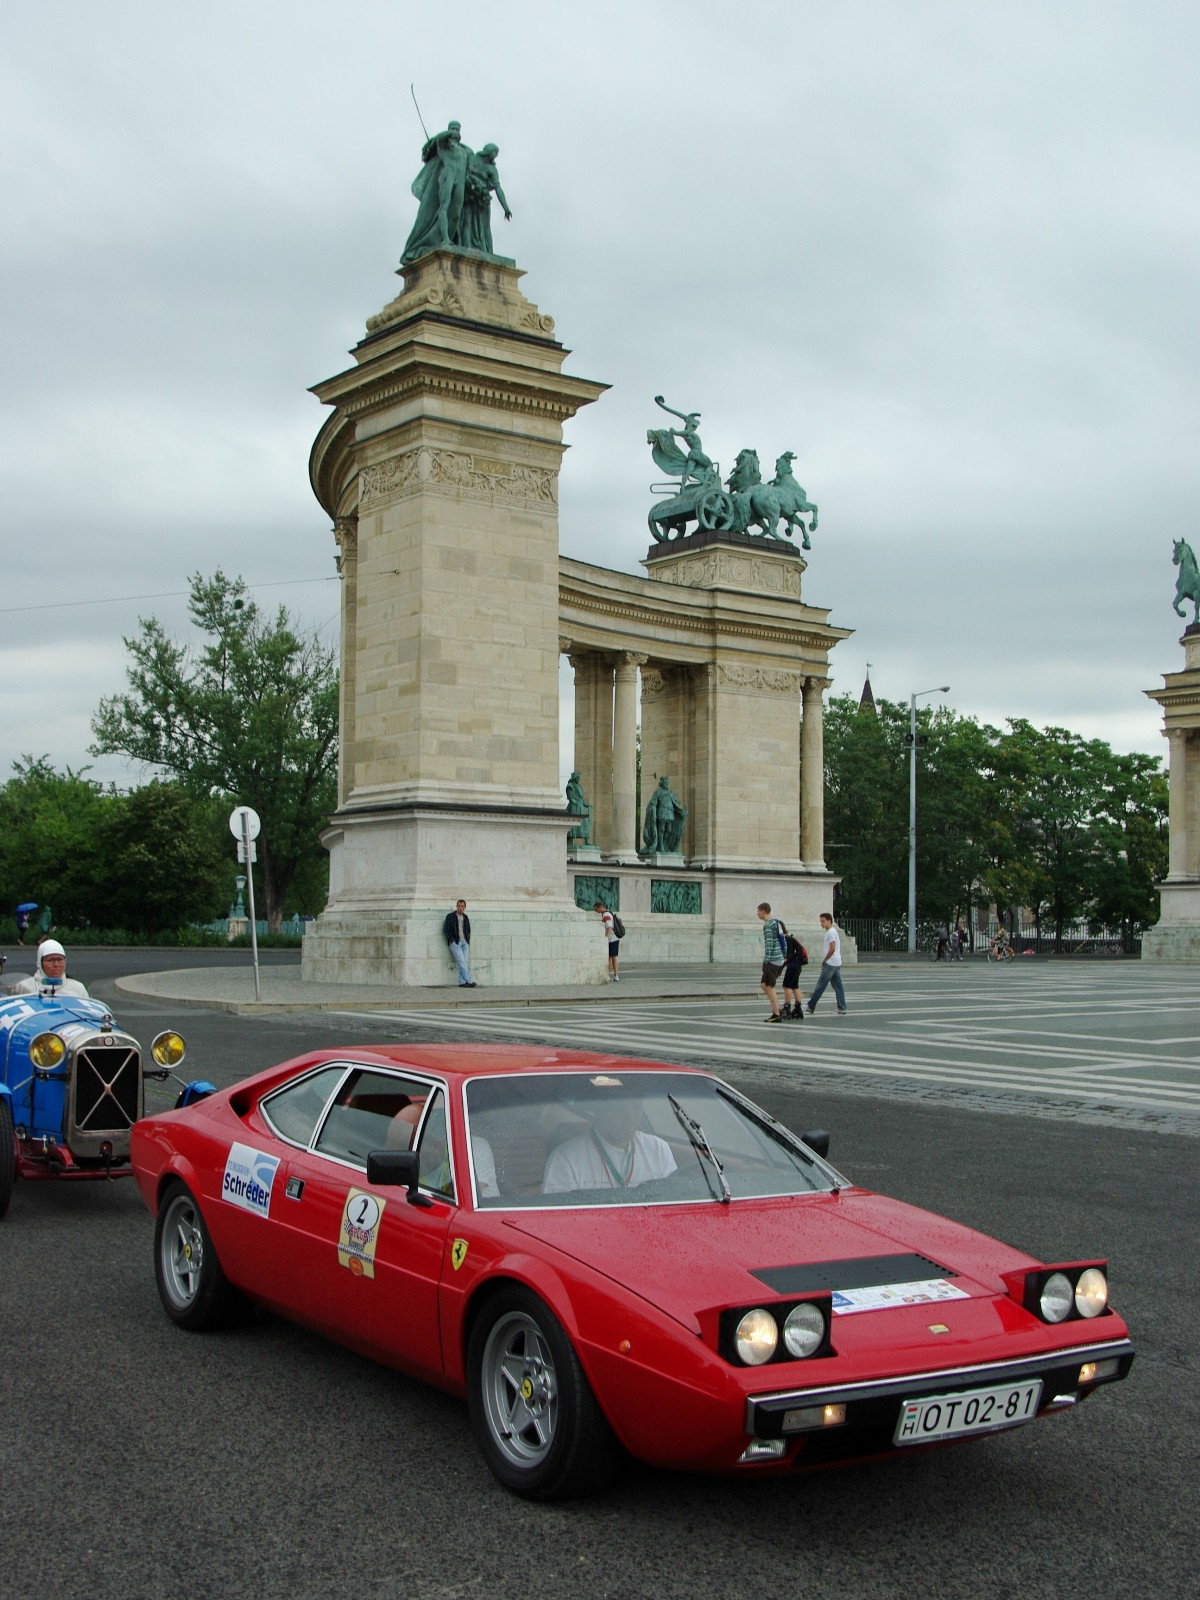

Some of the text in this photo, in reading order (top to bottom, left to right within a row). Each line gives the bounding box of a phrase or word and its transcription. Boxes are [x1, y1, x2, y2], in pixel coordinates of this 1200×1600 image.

[223, 1172, 270, 1207] Schréder
[356, 1199, 369, 1224] 2
[902, 1388, 1034, 1436] H OT02-81
